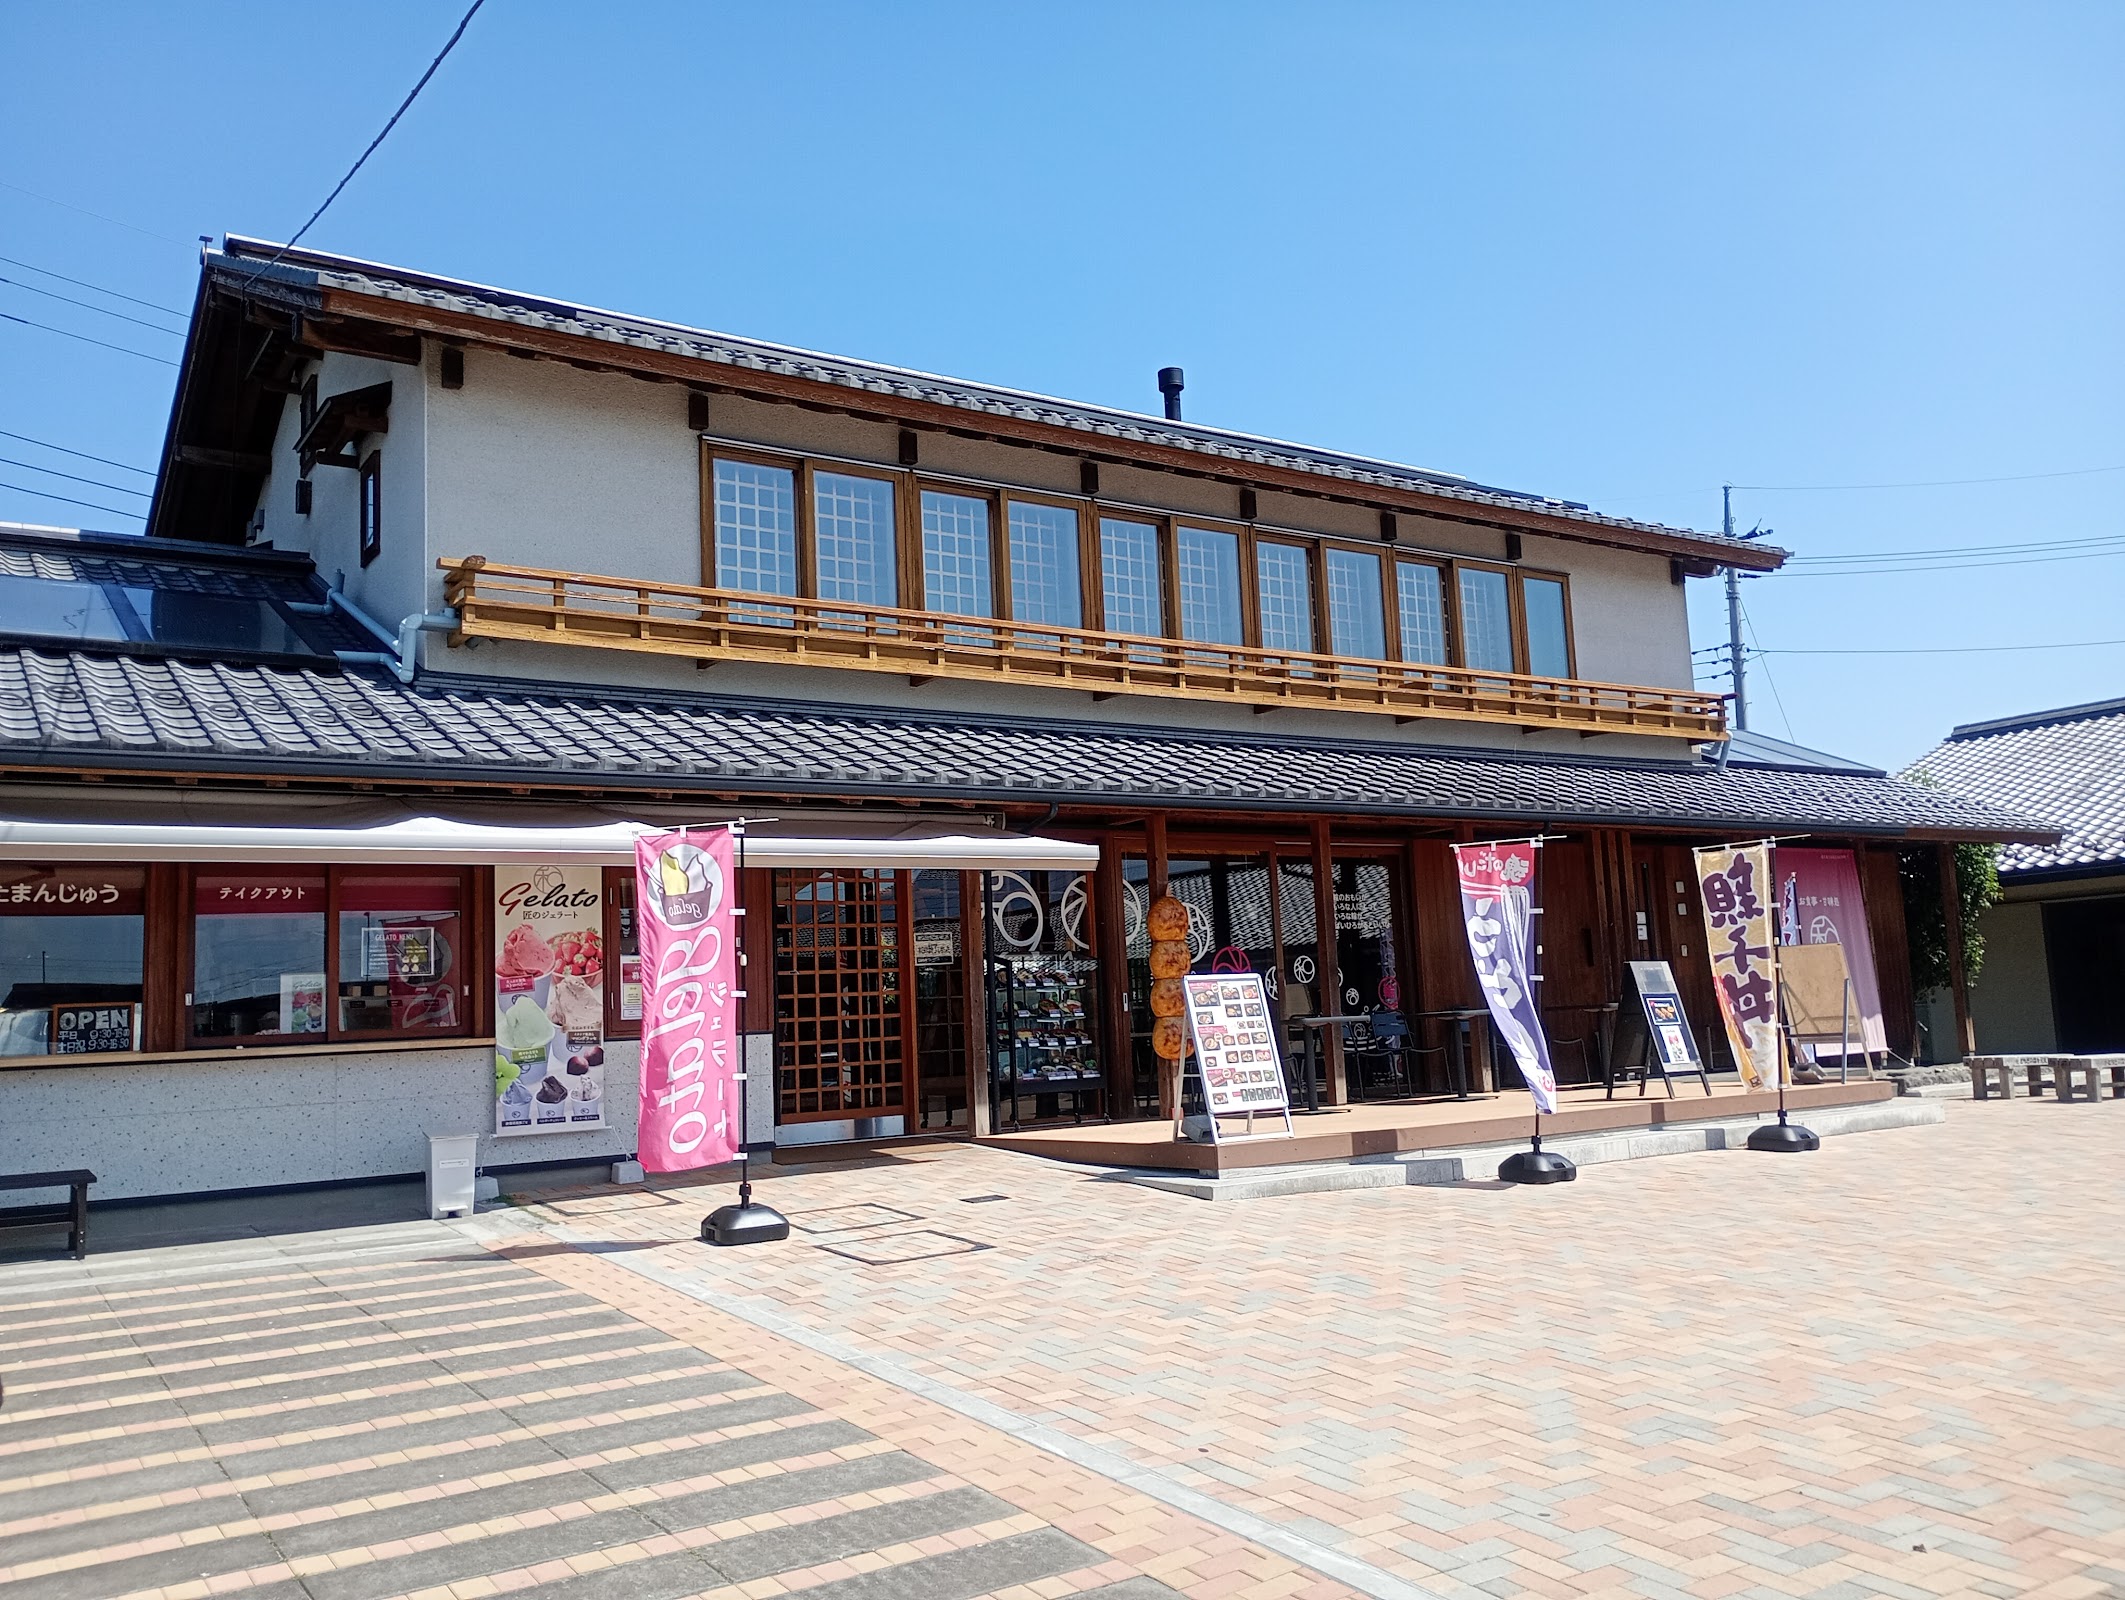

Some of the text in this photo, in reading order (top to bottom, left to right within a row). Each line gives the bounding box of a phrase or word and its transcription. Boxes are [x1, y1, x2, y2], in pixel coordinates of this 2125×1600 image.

[220, 887, 305, 899] テイクアウト
[499, 882, 599, 916] Gelato
[523, 910, 578, 920] 匠のジェラート
[59, 1009, 128, 1030] OPEN
[58, 1030, 77, 1040] 平日
[57, 1040, 86, 1053] 土日祝
